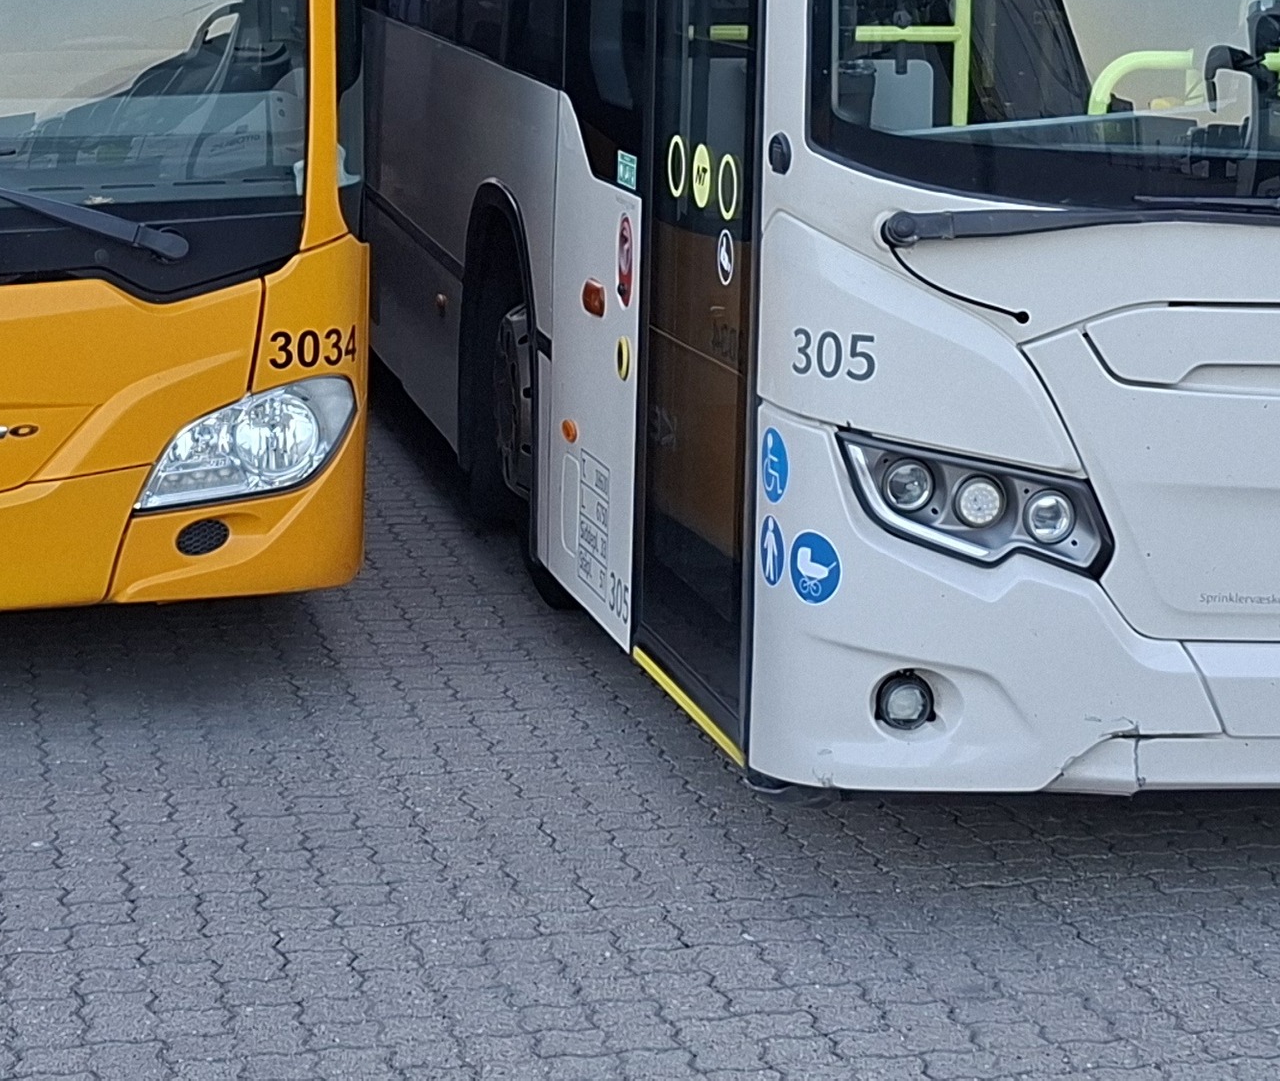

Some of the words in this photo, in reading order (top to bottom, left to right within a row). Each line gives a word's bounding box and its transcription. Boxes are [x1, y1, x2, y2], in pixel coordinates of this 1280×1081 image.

[695, 164, 708, 186] NT
[269, 324, 357, 370] 3034
[792, 327, 875, 382] 305
[608, 571, 629, 625] 305
